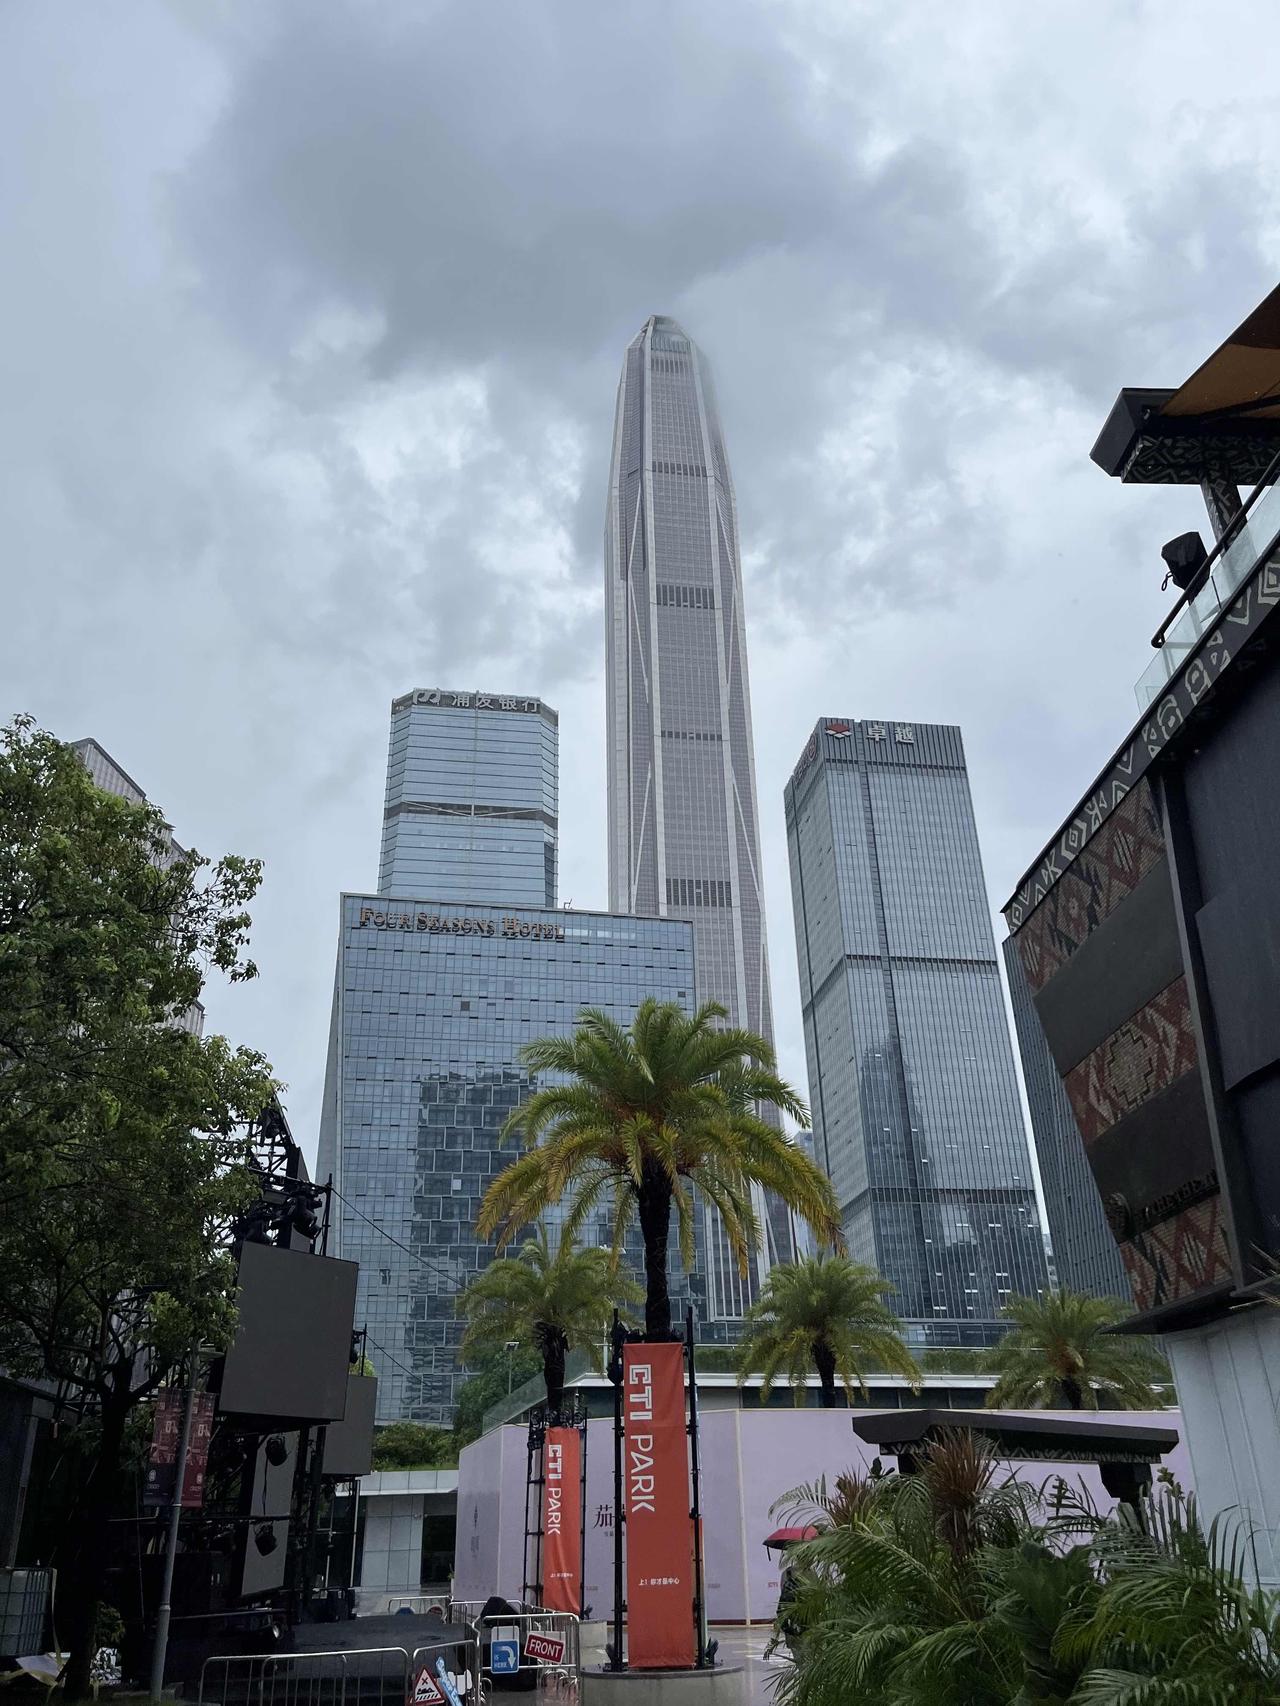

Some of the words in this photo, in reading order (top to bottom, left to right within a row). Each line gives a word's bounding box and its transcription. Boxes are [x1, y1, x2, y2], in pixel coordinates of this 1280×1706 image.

[451, 693, 541, 712] 浦发银行
[866, 724, 914, 743] 卓越
[630, 1434, 655, 1513] PARK
[547, 1487, 562, 1535] PARK
[529, 1639, 562, 1658] FRONT
